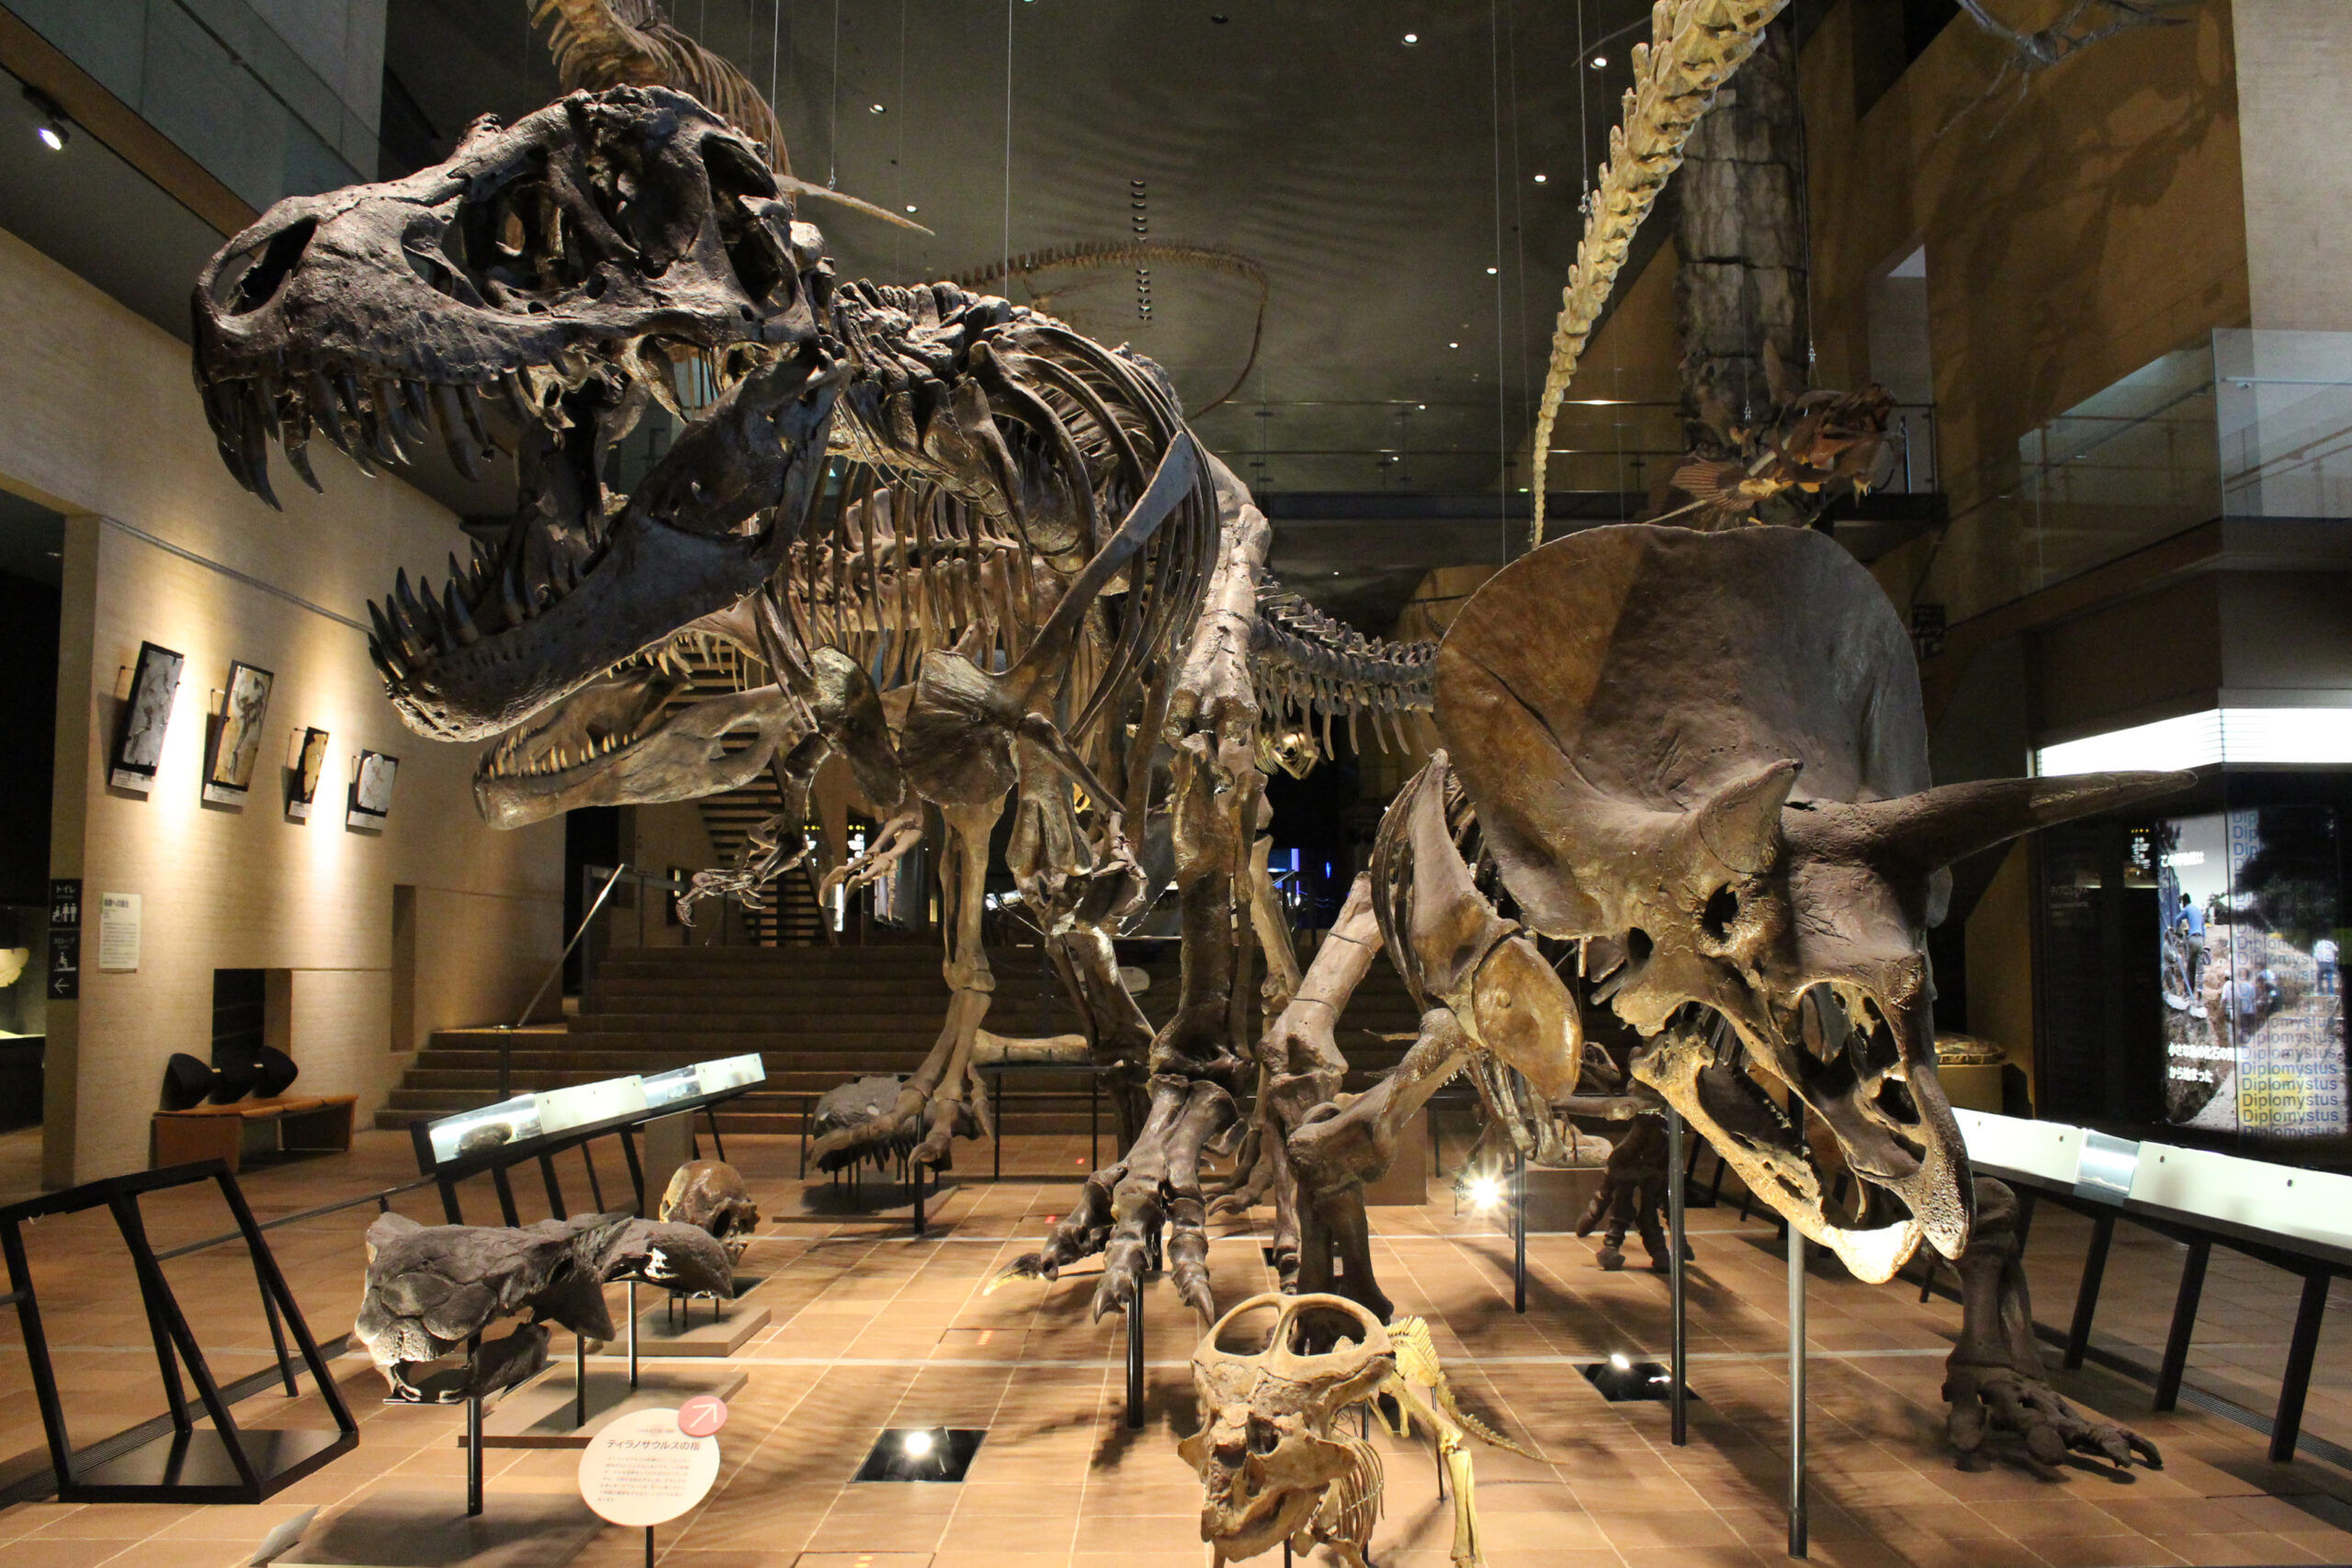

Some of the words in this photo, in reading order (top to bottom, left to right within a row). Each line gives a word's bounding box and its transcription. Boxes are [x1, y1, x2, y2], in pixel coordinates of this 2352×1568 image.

[56, 885, 75, 894] トイレ
[2241, 1030, 2335, 1045] Diplomystus
[2242, 1045, 2336, 1062] Diplomystus
[2242, 1062, 2337, 1077] Diplomystus
[2242, 1077, 2337, 1094] Diplomystus
[2243, 1093, 2338, 1110] Diplomystus
[2244, 1109, 2339, 1125] Diplomystus
[607, 1439, 700, 1451] ティラノサウルスの指
